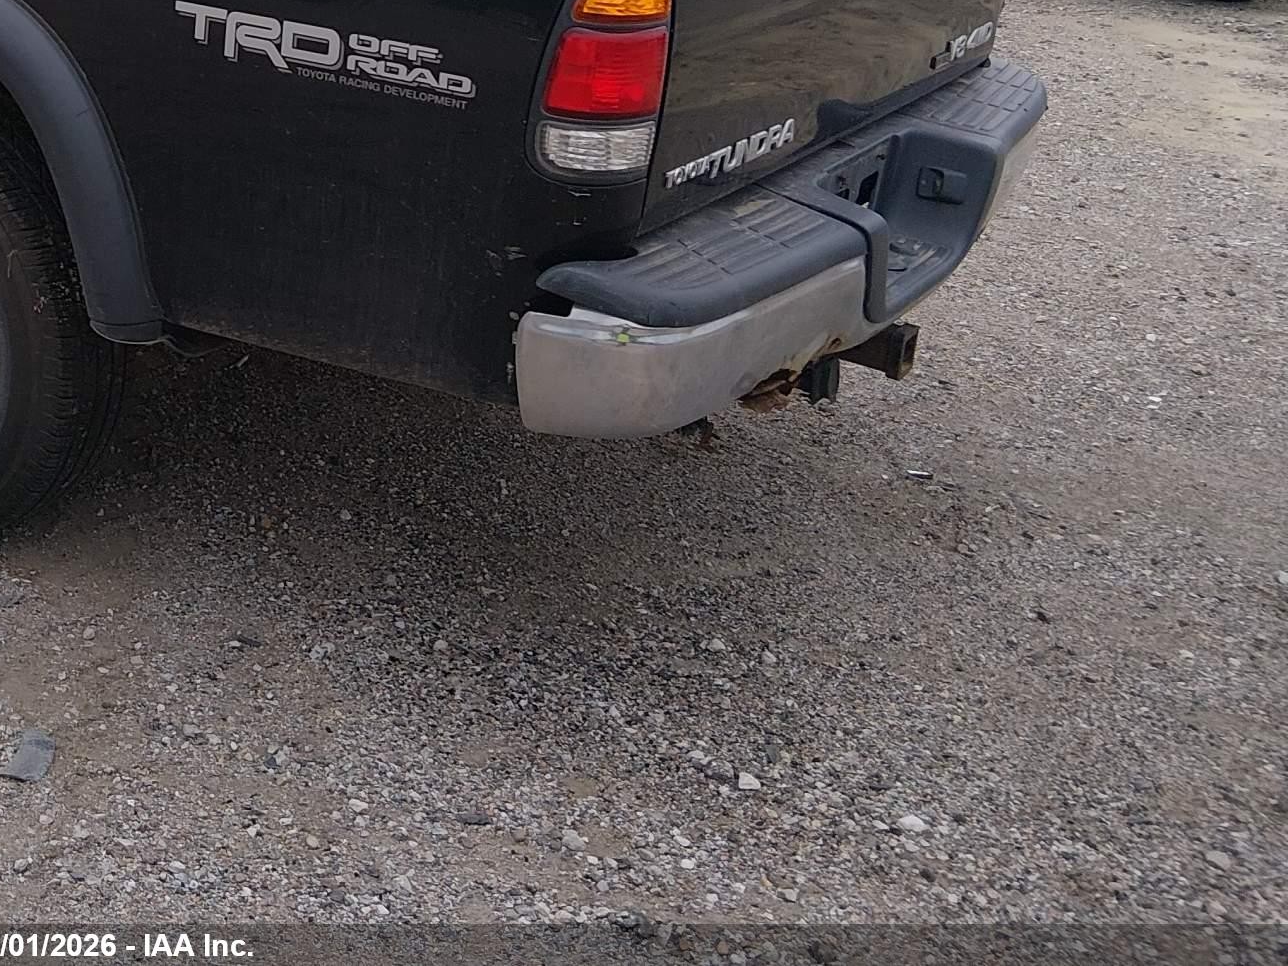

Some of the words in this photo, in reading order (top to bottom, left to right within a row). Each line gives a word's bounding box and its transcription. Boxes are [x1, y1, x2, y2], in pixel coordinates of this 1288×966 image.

[174, 0, 345, 75] TRD
[347, 33, 445, 65] OFF
[296, 66, 337, 84] TOYOTA
[338, 75, 381, 92] RACING
[383, 84, 469, 111] DEVELOPMENT
[346, 54, 477, 99] ROAD
[664, 154, 712, 189] TOYOTA
[709, 118, 795, 179] TUNDRA
